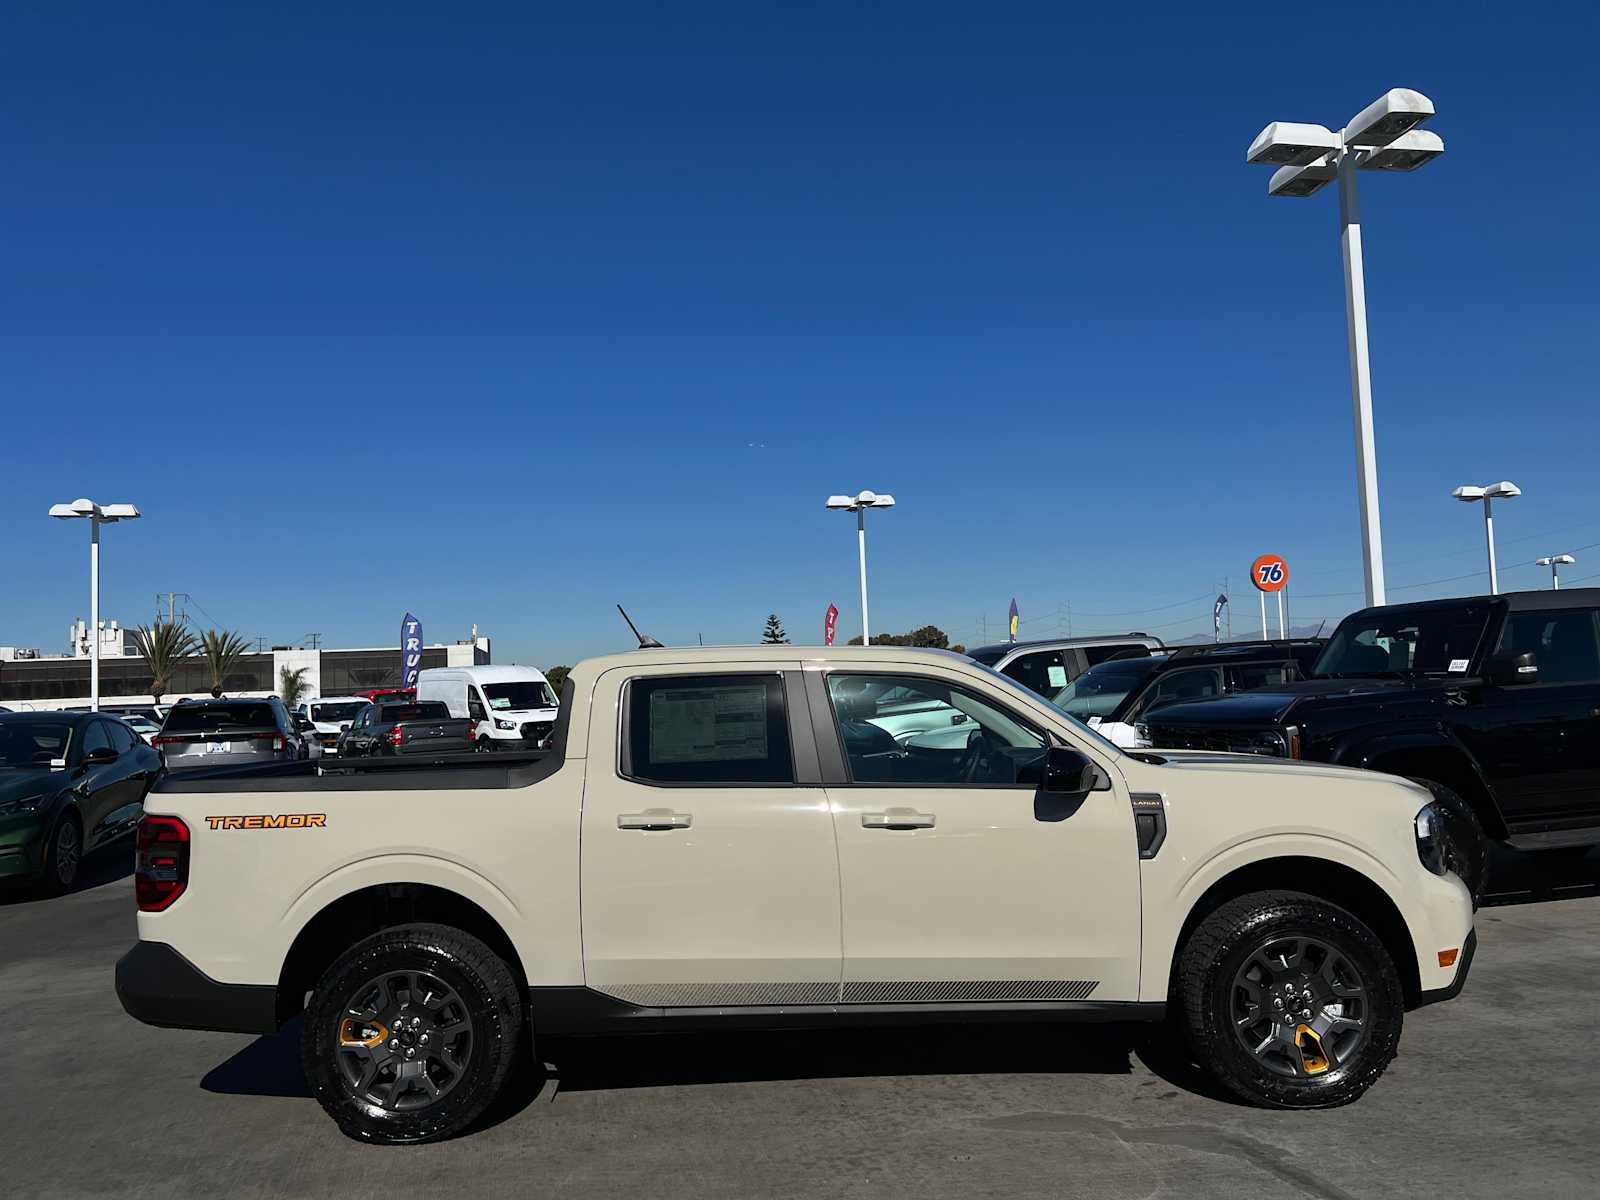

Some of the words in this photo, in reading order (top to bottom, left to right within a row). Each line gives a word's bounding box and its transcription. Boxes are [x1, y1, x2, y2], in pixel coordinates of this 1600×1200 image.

[1259, 562, 1284, 584] 76
[406, 621, 421, 689] TRUC
[205, 813, 327, 830] TREMOR
